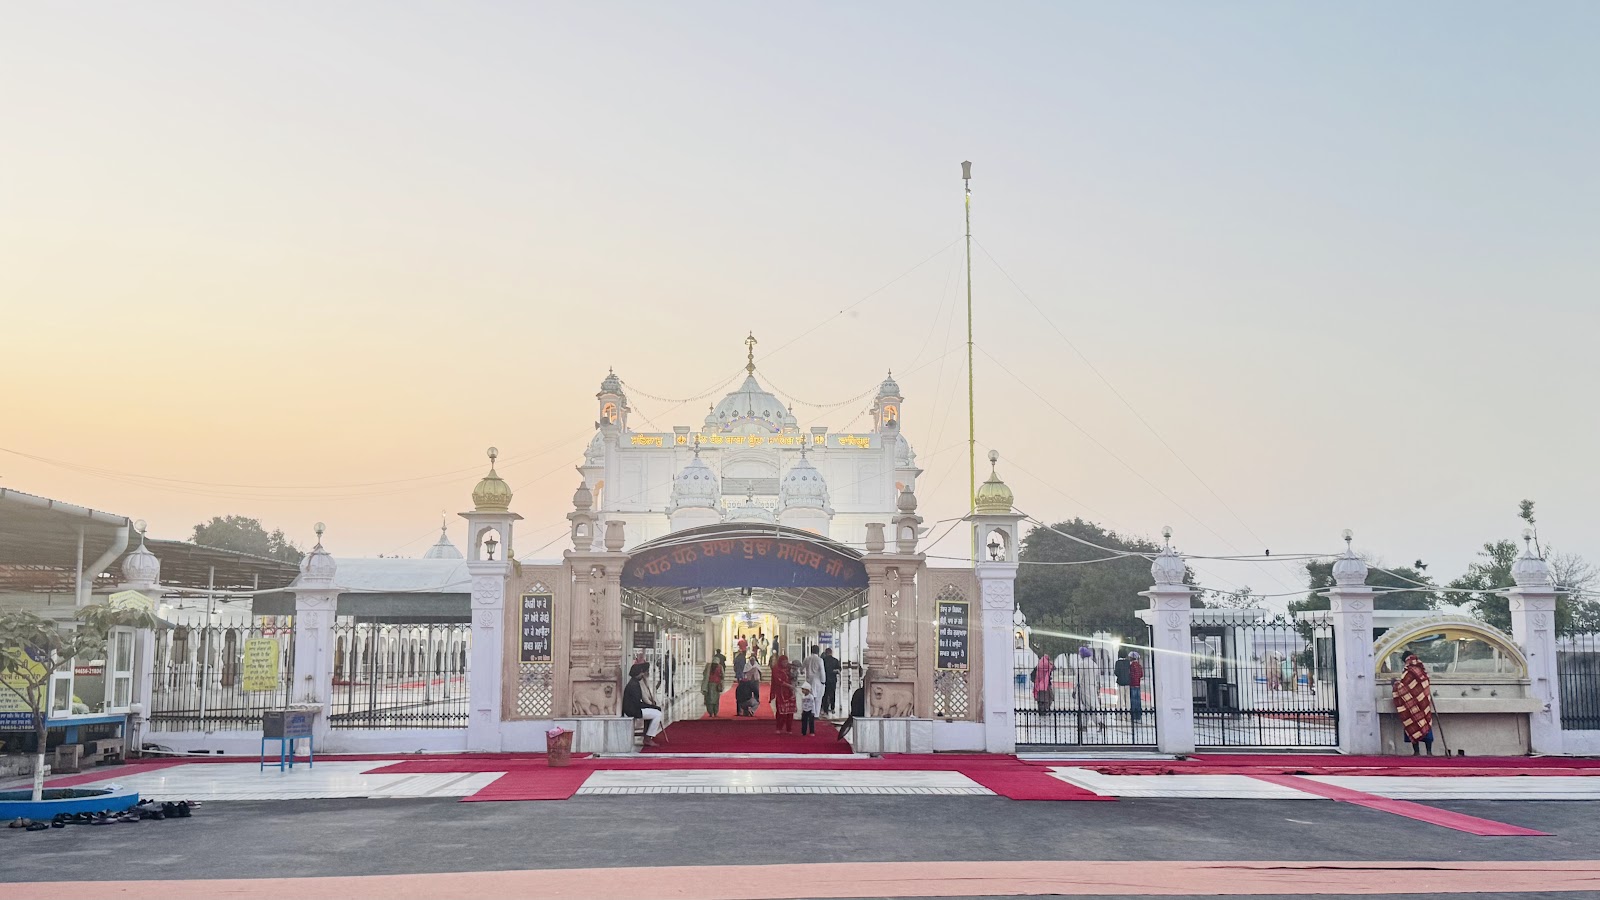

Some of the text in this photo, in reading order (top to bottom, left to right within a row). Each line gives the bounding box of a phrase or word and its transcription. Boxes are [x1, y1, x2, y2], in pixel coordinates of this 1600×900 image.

[646, 554, 670, 574] ਧੰਨ
[672, 545, 698, 564] ਧੰਨ
[702, 540, 735, 556] ਬਾਬਾ
[776, 543, 824, 570] ਸਾਹਿਬ
[826, 558, 844, 577] ਜੀ
